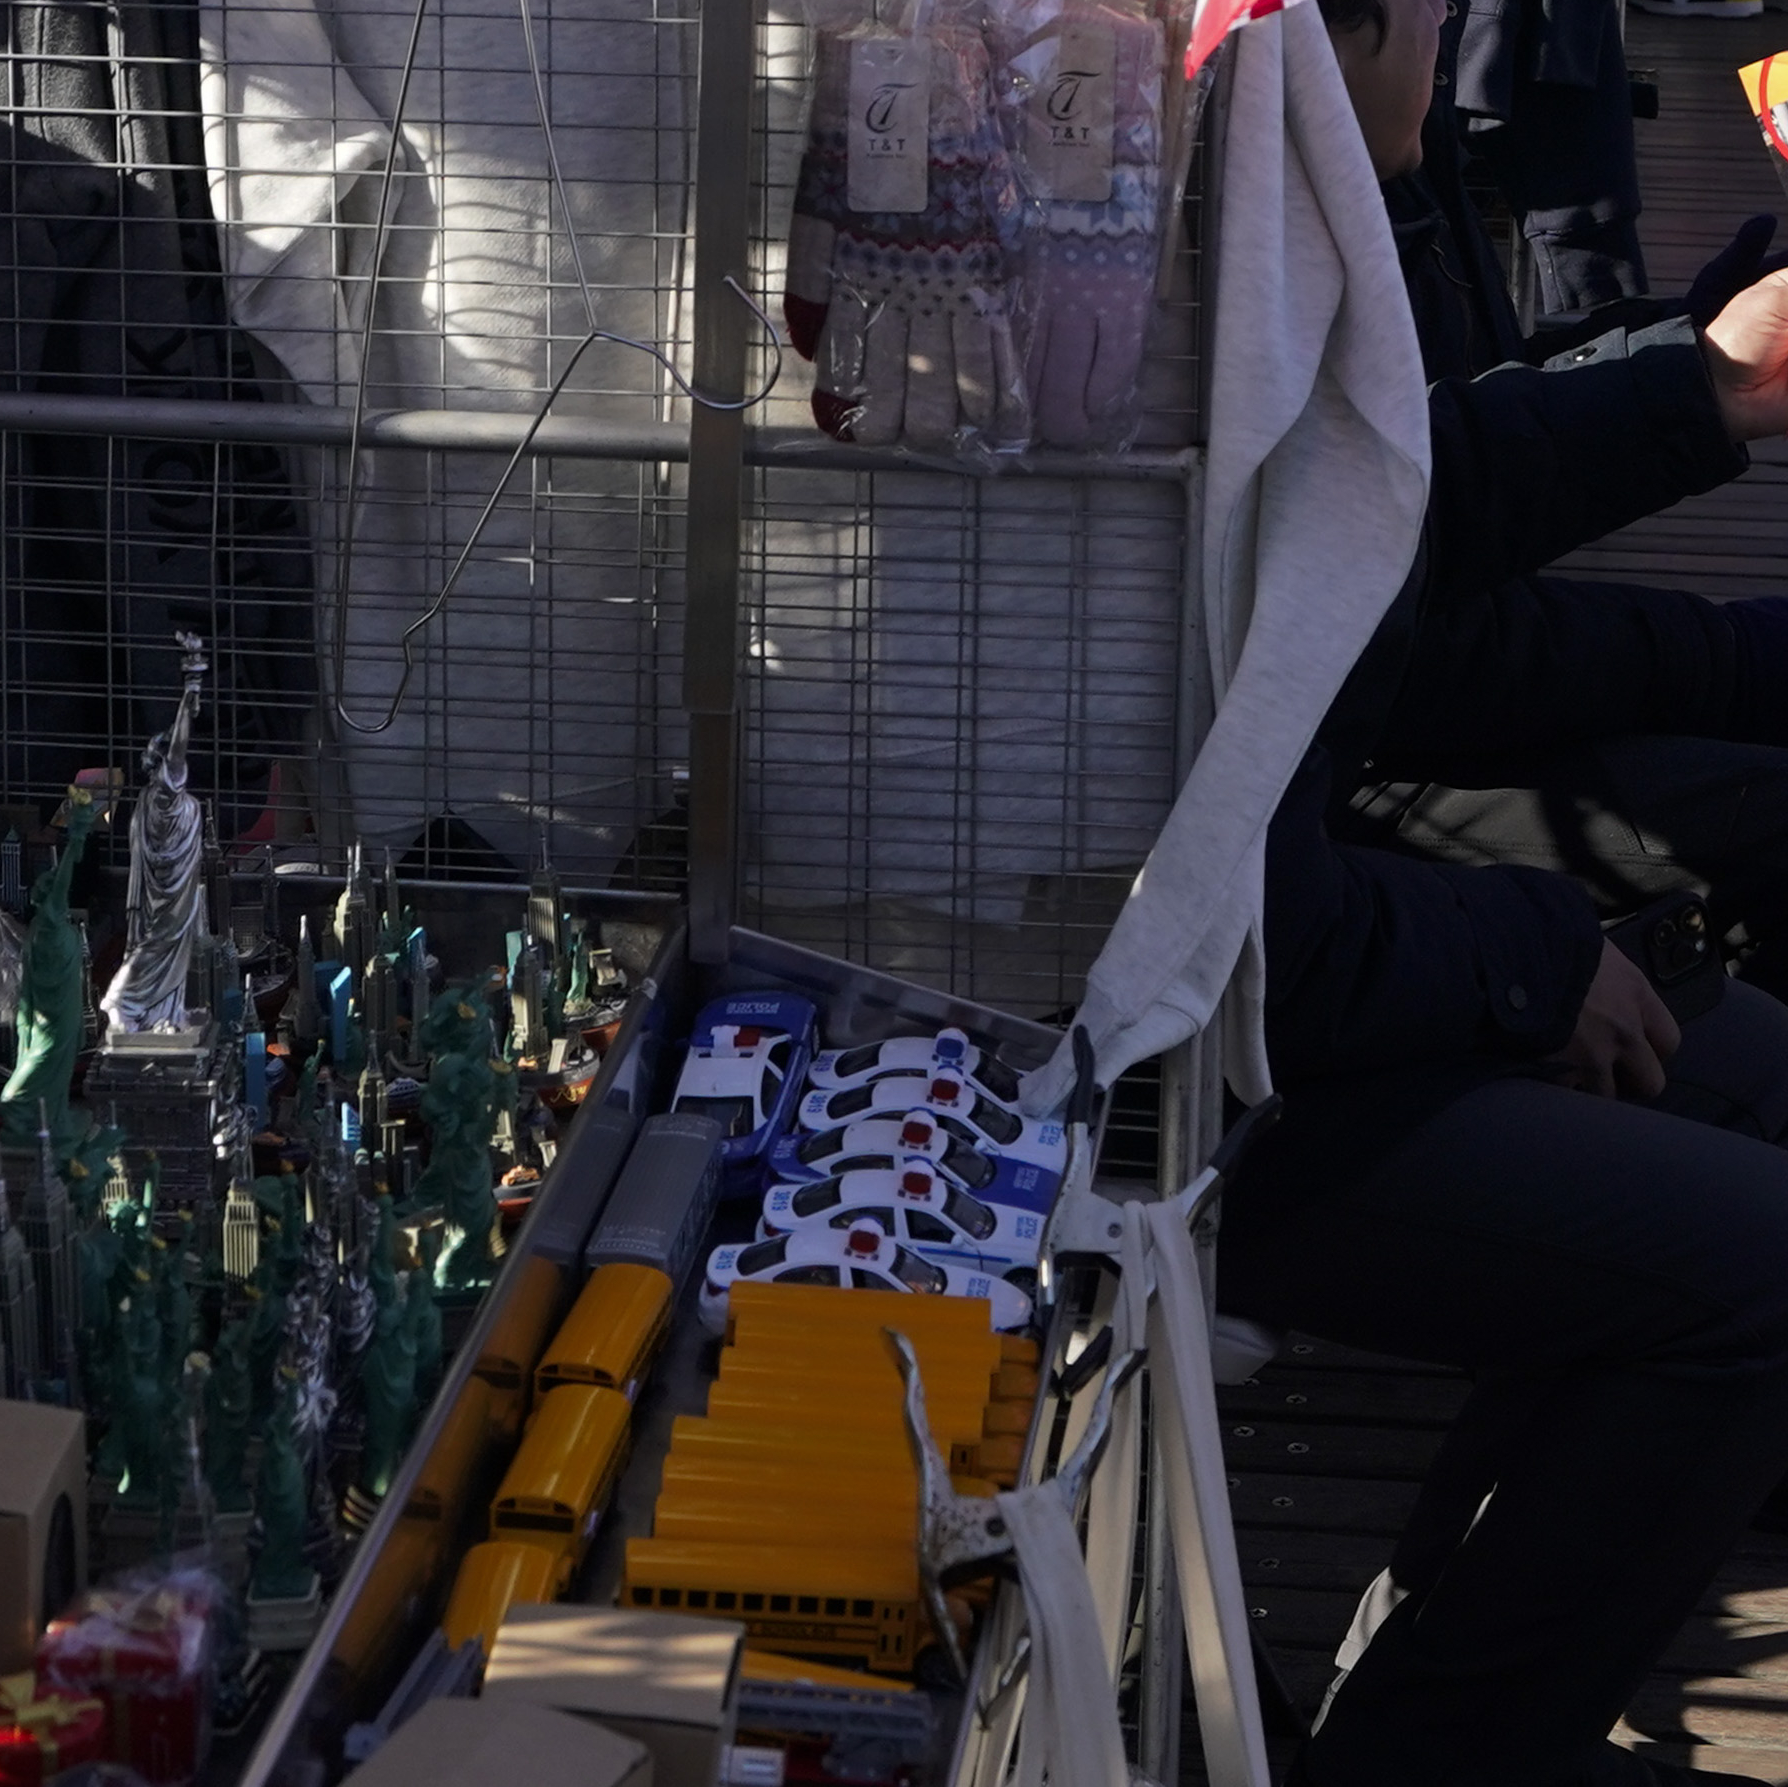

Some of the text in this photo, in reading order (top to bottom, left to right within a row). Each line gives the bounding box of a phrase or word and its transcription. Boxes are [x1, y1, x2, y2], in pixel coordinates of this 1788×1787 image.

[1051, 125, 1090, 140] T & T
[869, 138, 906, 151] T & T
